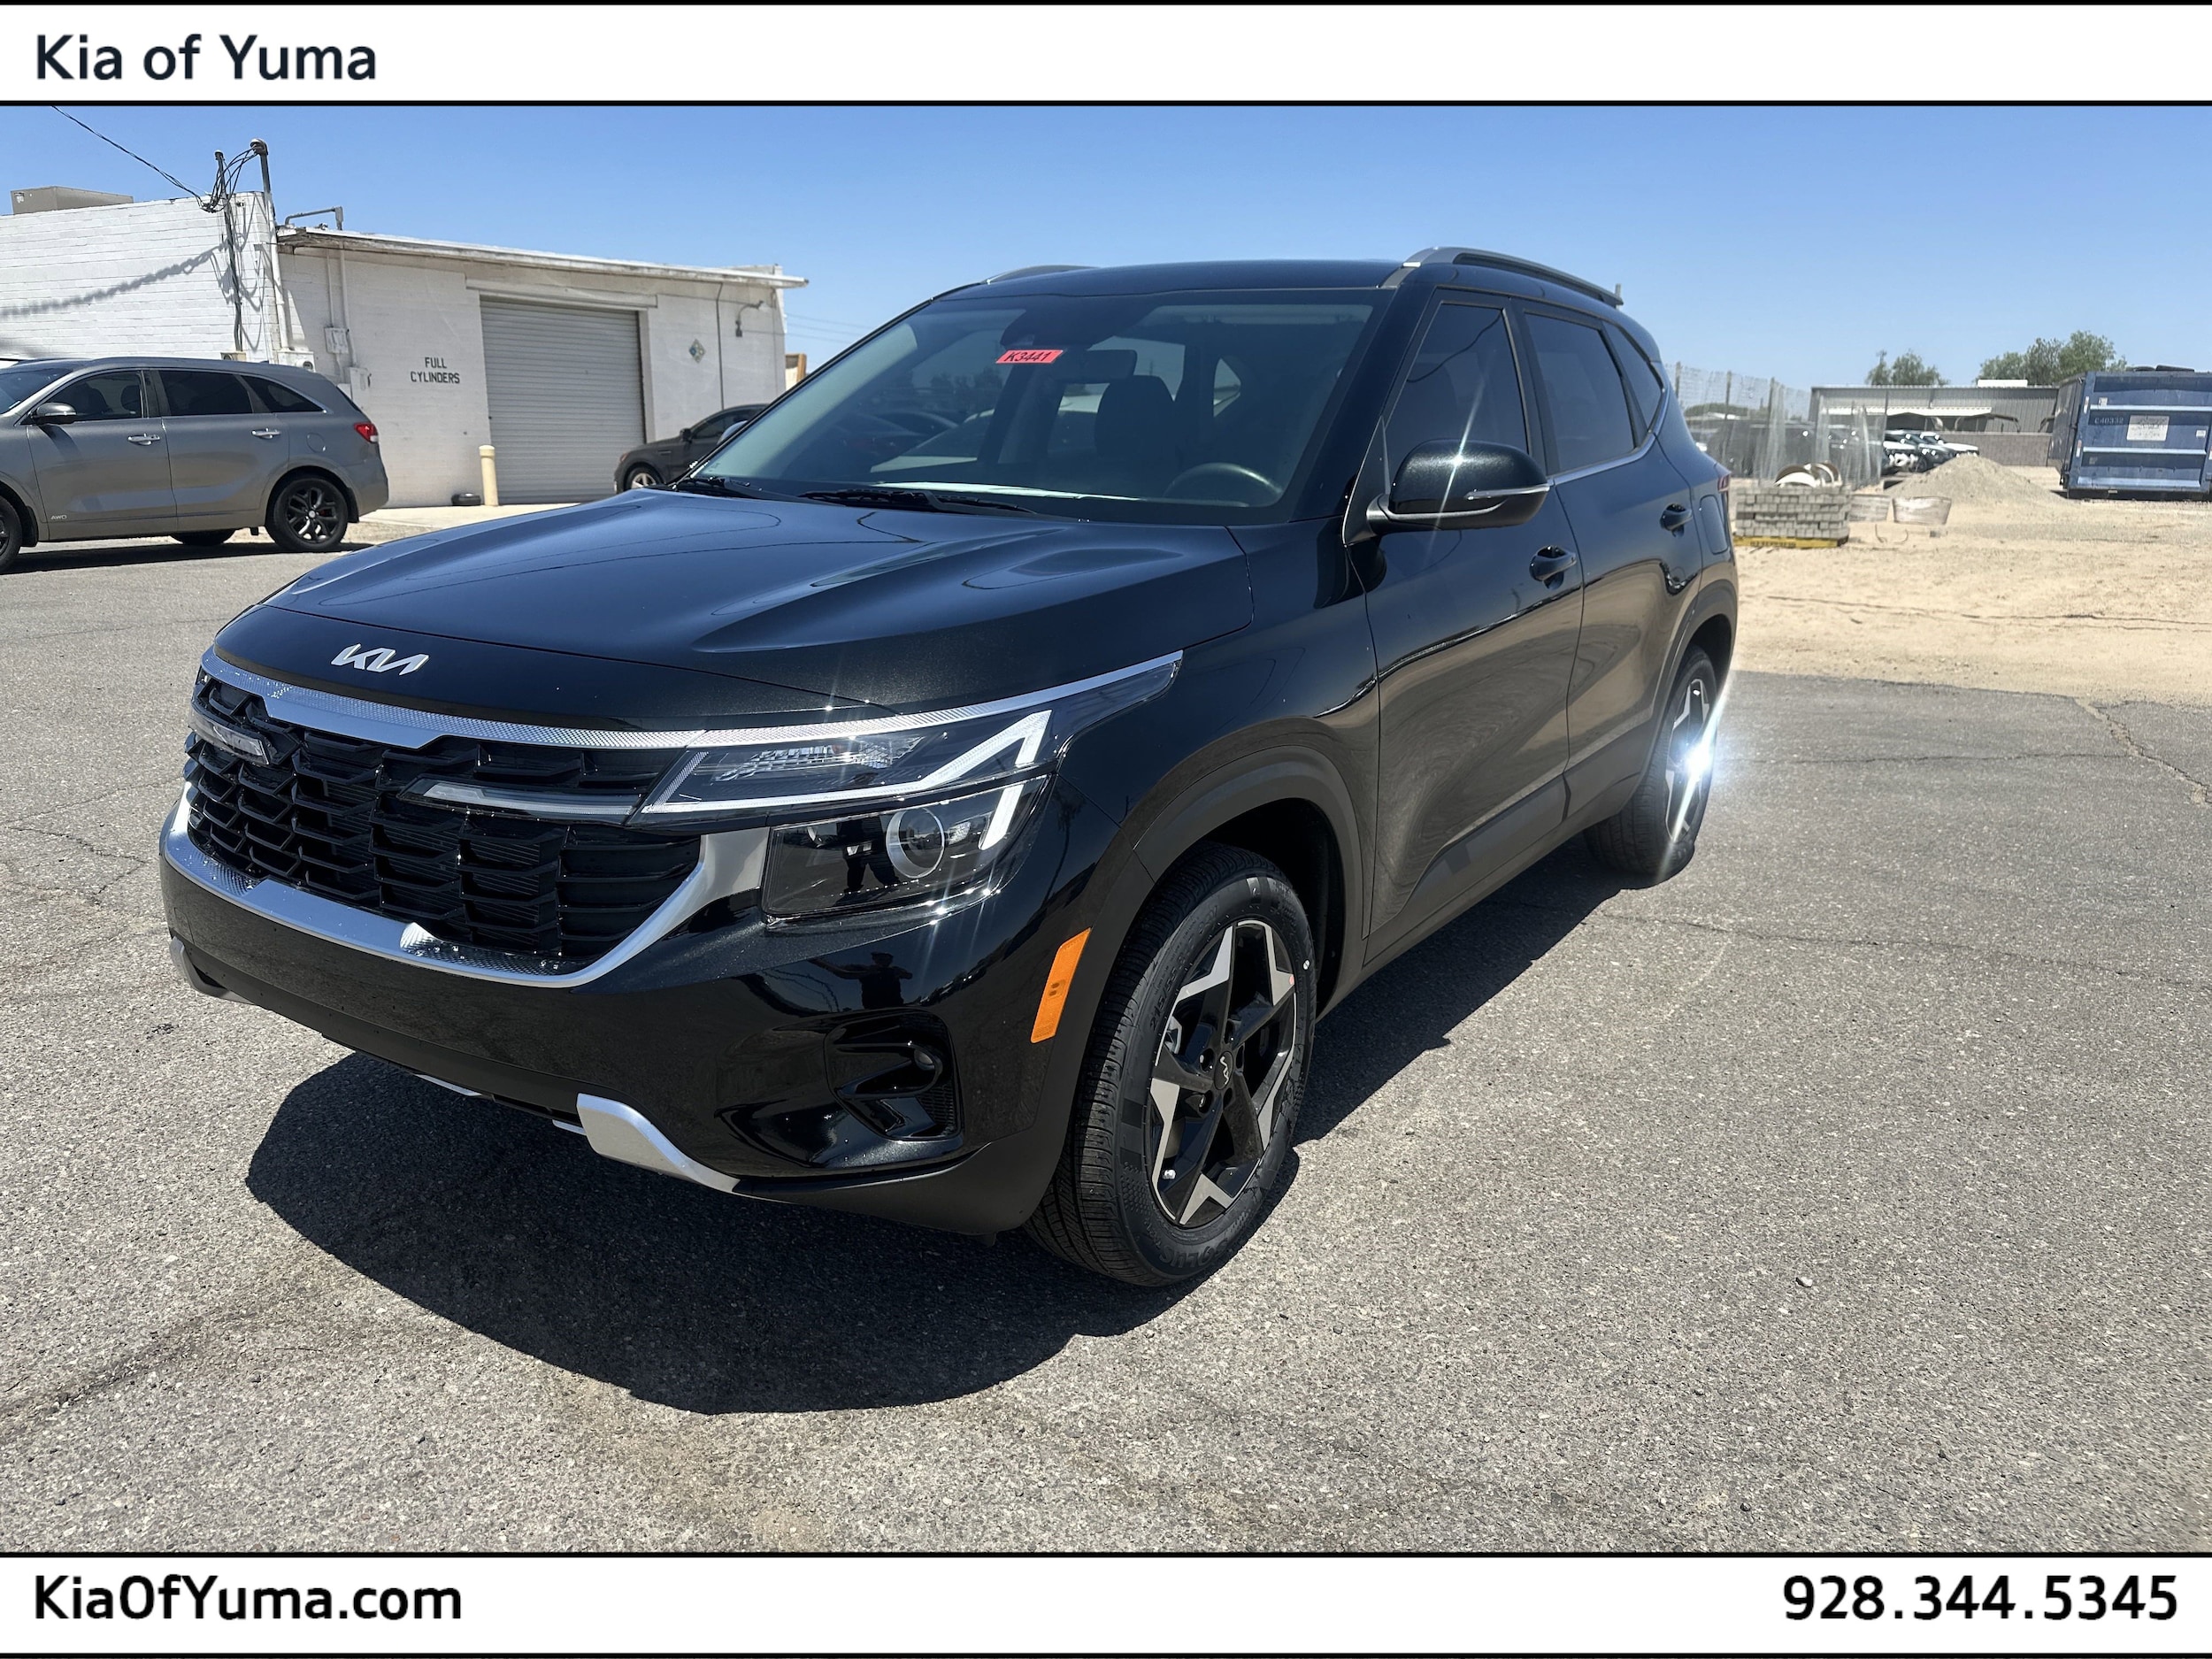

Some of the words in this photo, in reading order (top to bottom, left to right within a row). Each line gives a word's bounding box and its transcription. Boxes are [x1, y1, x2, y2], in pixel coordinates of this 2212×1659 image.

[1003, 351, 1053, 362] K3441
[425, 357, 447, 369] FULL
[411, 371, 460, 384] CYLINDERS
